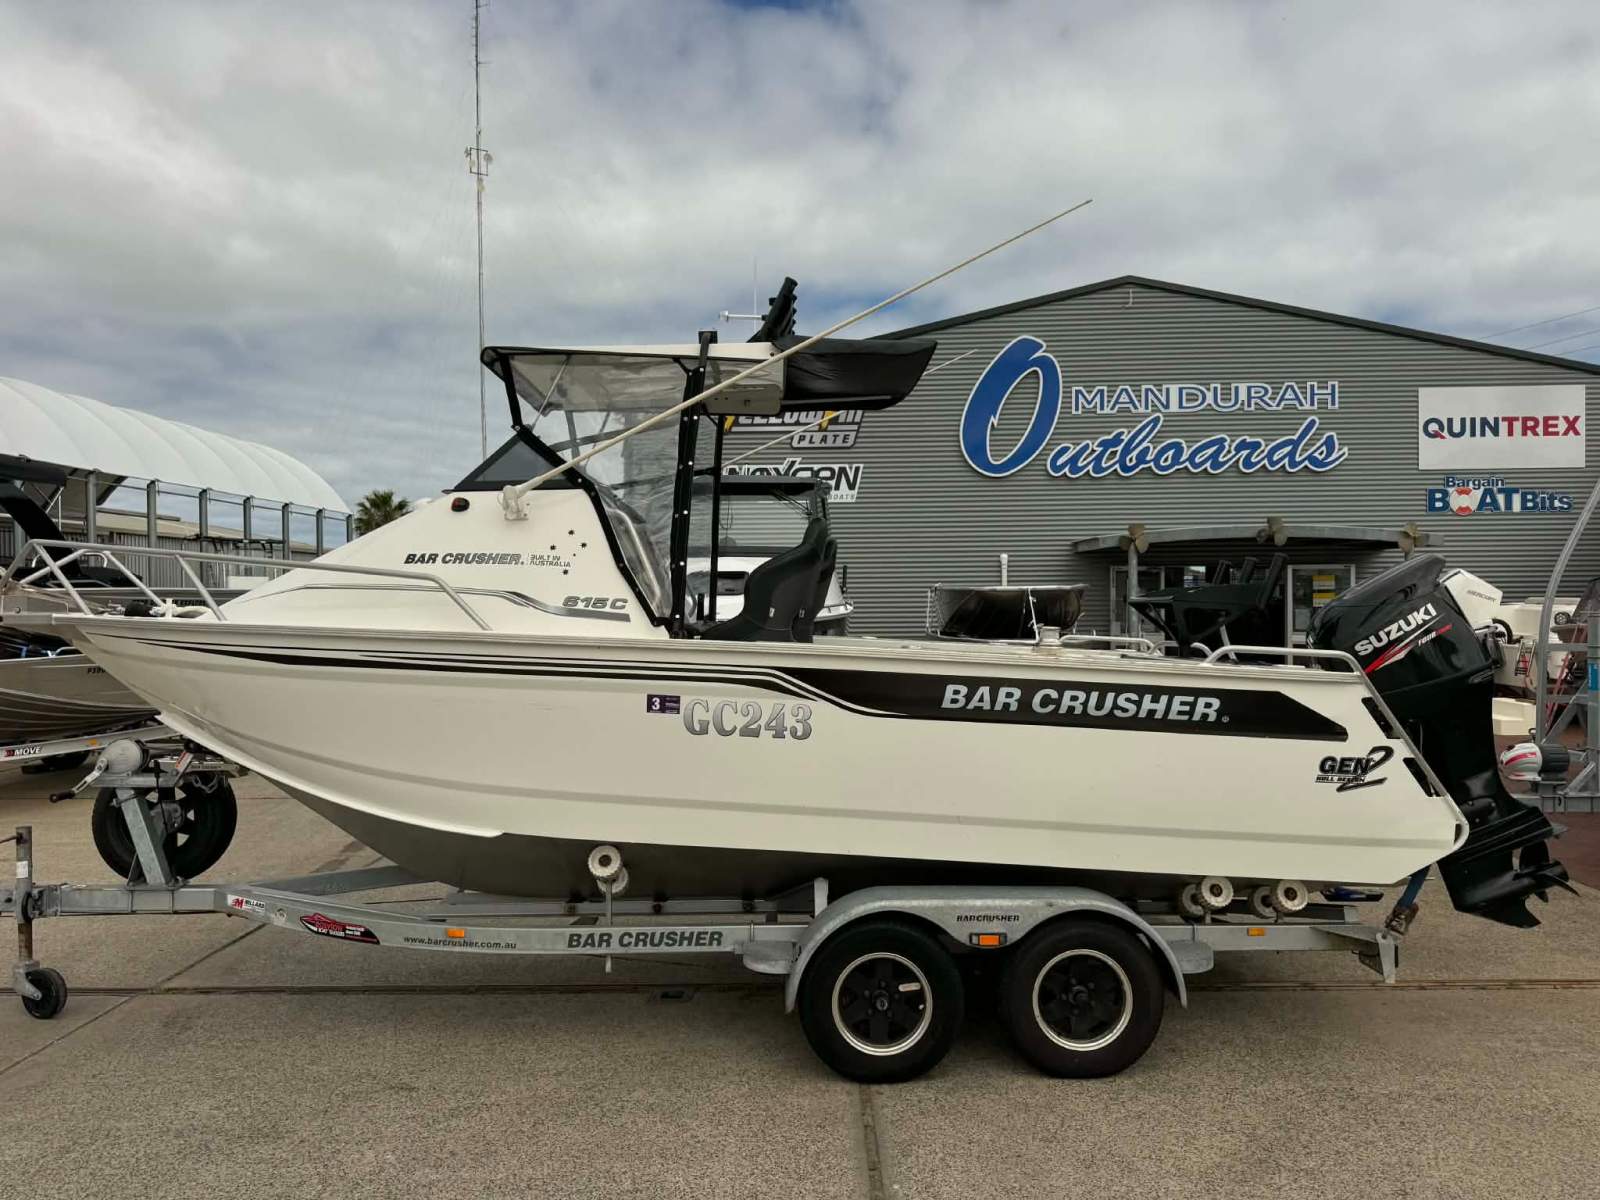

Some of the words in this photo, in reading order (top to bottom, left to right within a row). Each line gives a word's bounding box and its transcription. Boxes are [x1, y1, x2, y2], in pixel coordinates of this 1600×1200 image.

[1070, 381, 1340, 416] MANDURAH
[1422, 415, 1582, 440] QUINTREX
[797, 433, 851, 445] PLATE
[1445, 475, 1505, 490] Bargain
[404, 552, 439, 565] BAR
[441, 552, 522, 565] CRUSHER
[529, 560, 571, 568] AUSTRALIA
[1354, 603, 1437, 656] SUZUKI
[651, 697, 660, 710] 3
[941, 684, 1022, 712] BAR
[1031, 688, 1221, 722] CRUSHER
[683, 698, 813, 740] GC243
[14, 746, 41, 756] MOVE
[1319, 756, 1370, 774] GEN
[403, 936, 517, 950] www.barcrusher.com.au
[567, 932, 613, 949] BAR
[618, 930, 724, 948] CRUSHER
